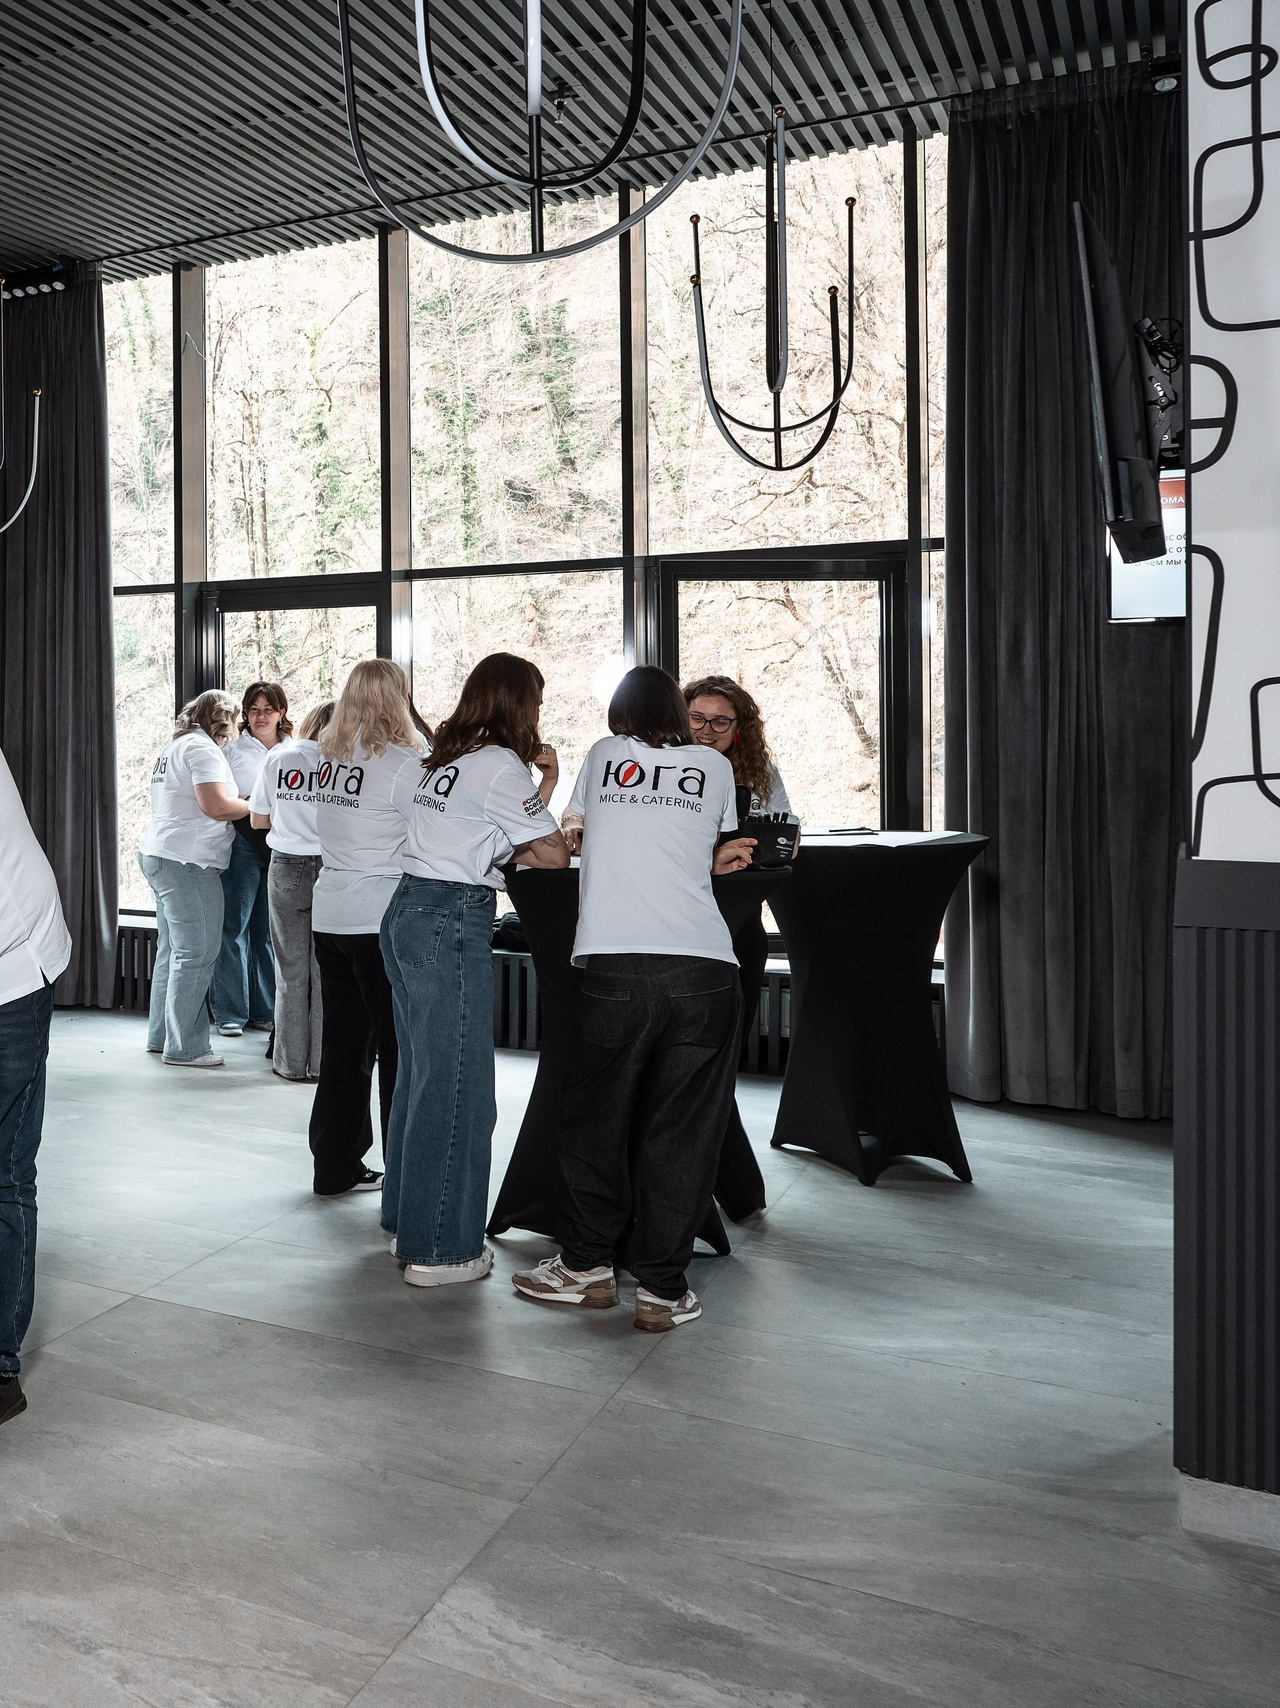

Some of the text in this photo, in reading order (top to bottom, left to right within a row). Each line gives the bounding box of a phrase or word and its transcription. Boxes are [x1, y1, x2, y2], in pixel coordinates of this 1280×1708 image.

[276, 793, 294, 801] MICE
[296, 793, 301, 801] &
[327, 794, 359, 808] CATERING
[600, 794, 702, 813] MICE & CATERING
